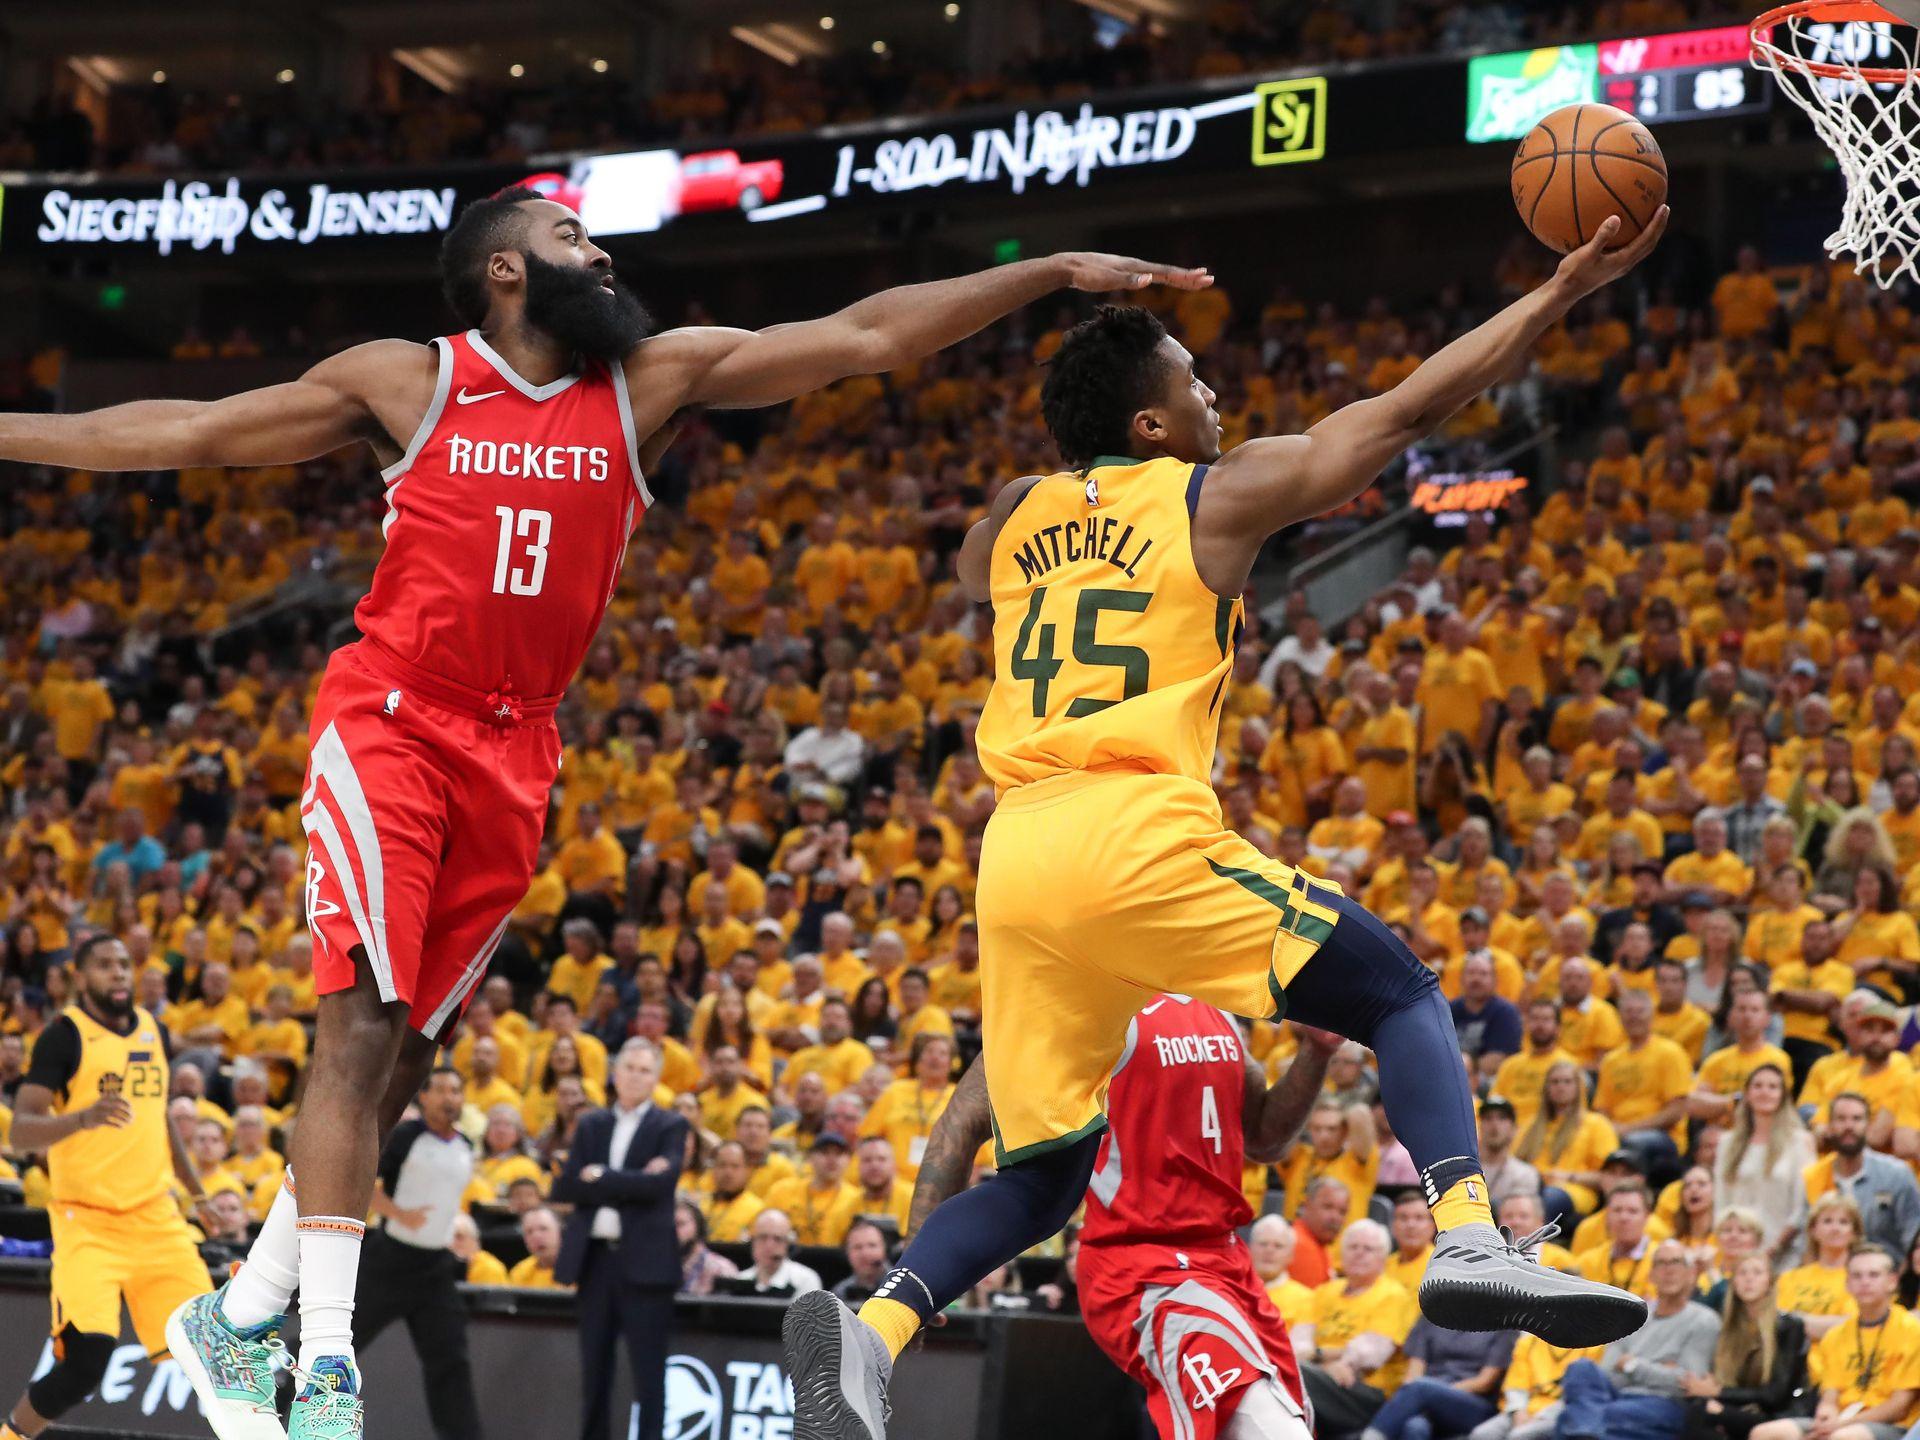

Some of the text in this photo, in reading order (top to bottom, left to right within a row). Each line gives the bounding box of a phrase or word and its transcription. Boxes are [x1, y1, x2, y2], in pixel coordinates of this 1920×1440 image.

[1808, 22, 1892, 63] 7:01
[1693, 68, 1746, 110] 85
[37, 184, 457, 244] SIEGFRD & JENSEN
[445, 432, 609, 482] ROCKETS
[493, 505, 552, 597] 13
[1013, 516, 1153, 585] MITCHELL
[1011, 586, 1154, 718] 45
[1152, 1034, 1239, 1068] ROCKETS
[132, 1066, 163, 1098] 23
[1201, 1085, 1222, 1155] 4
